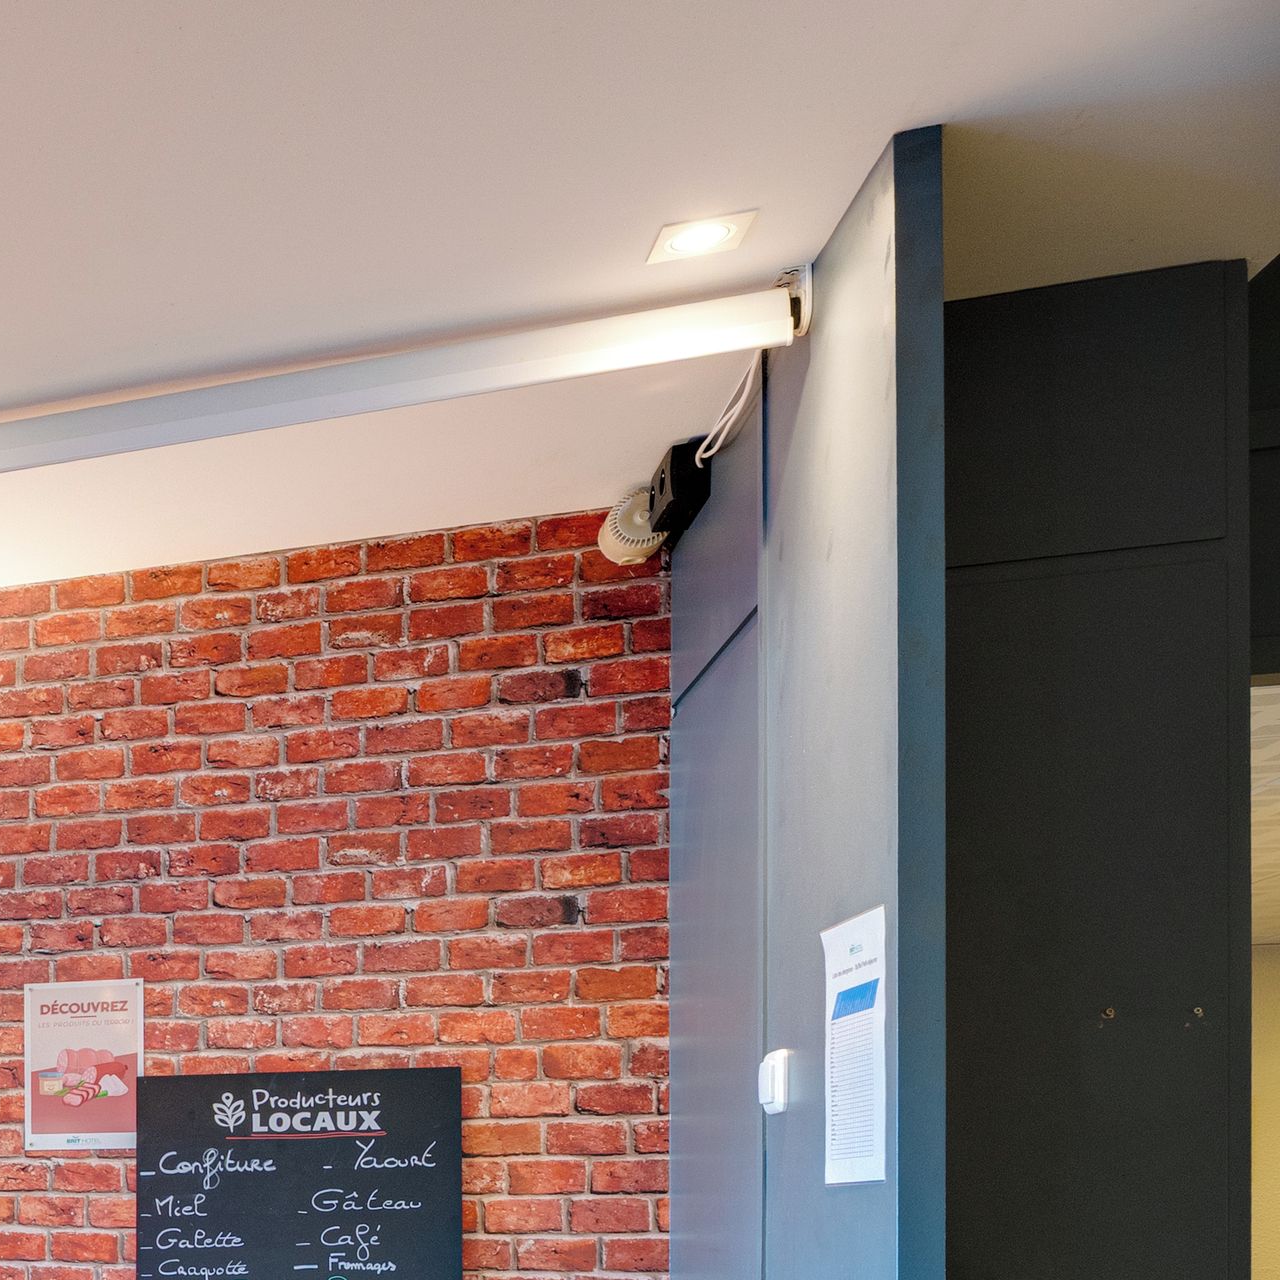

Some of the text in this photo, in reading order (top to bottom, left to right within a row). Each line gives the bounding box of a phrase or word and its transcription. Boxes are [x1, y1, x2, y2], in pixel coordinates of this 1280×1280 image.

[40, 1000, 128, 1015] DÉCOUVREZ
[252, 1088, 380, 1111] Producteurs
[252, 1110, 381, 1133] LOCAUX
[354, 1139, 436, 1170] Yaourt
[159, 1148, 276, 1190] Confiture
[155, 1194, 208, 1217] Miel
[311, 1188, 421, 1212] Gâteau
[156, 1228, 244, 1249] Galette
[320, 1224, 380, 1261] Café
[329, 1253, 397, 1275] Fromages
